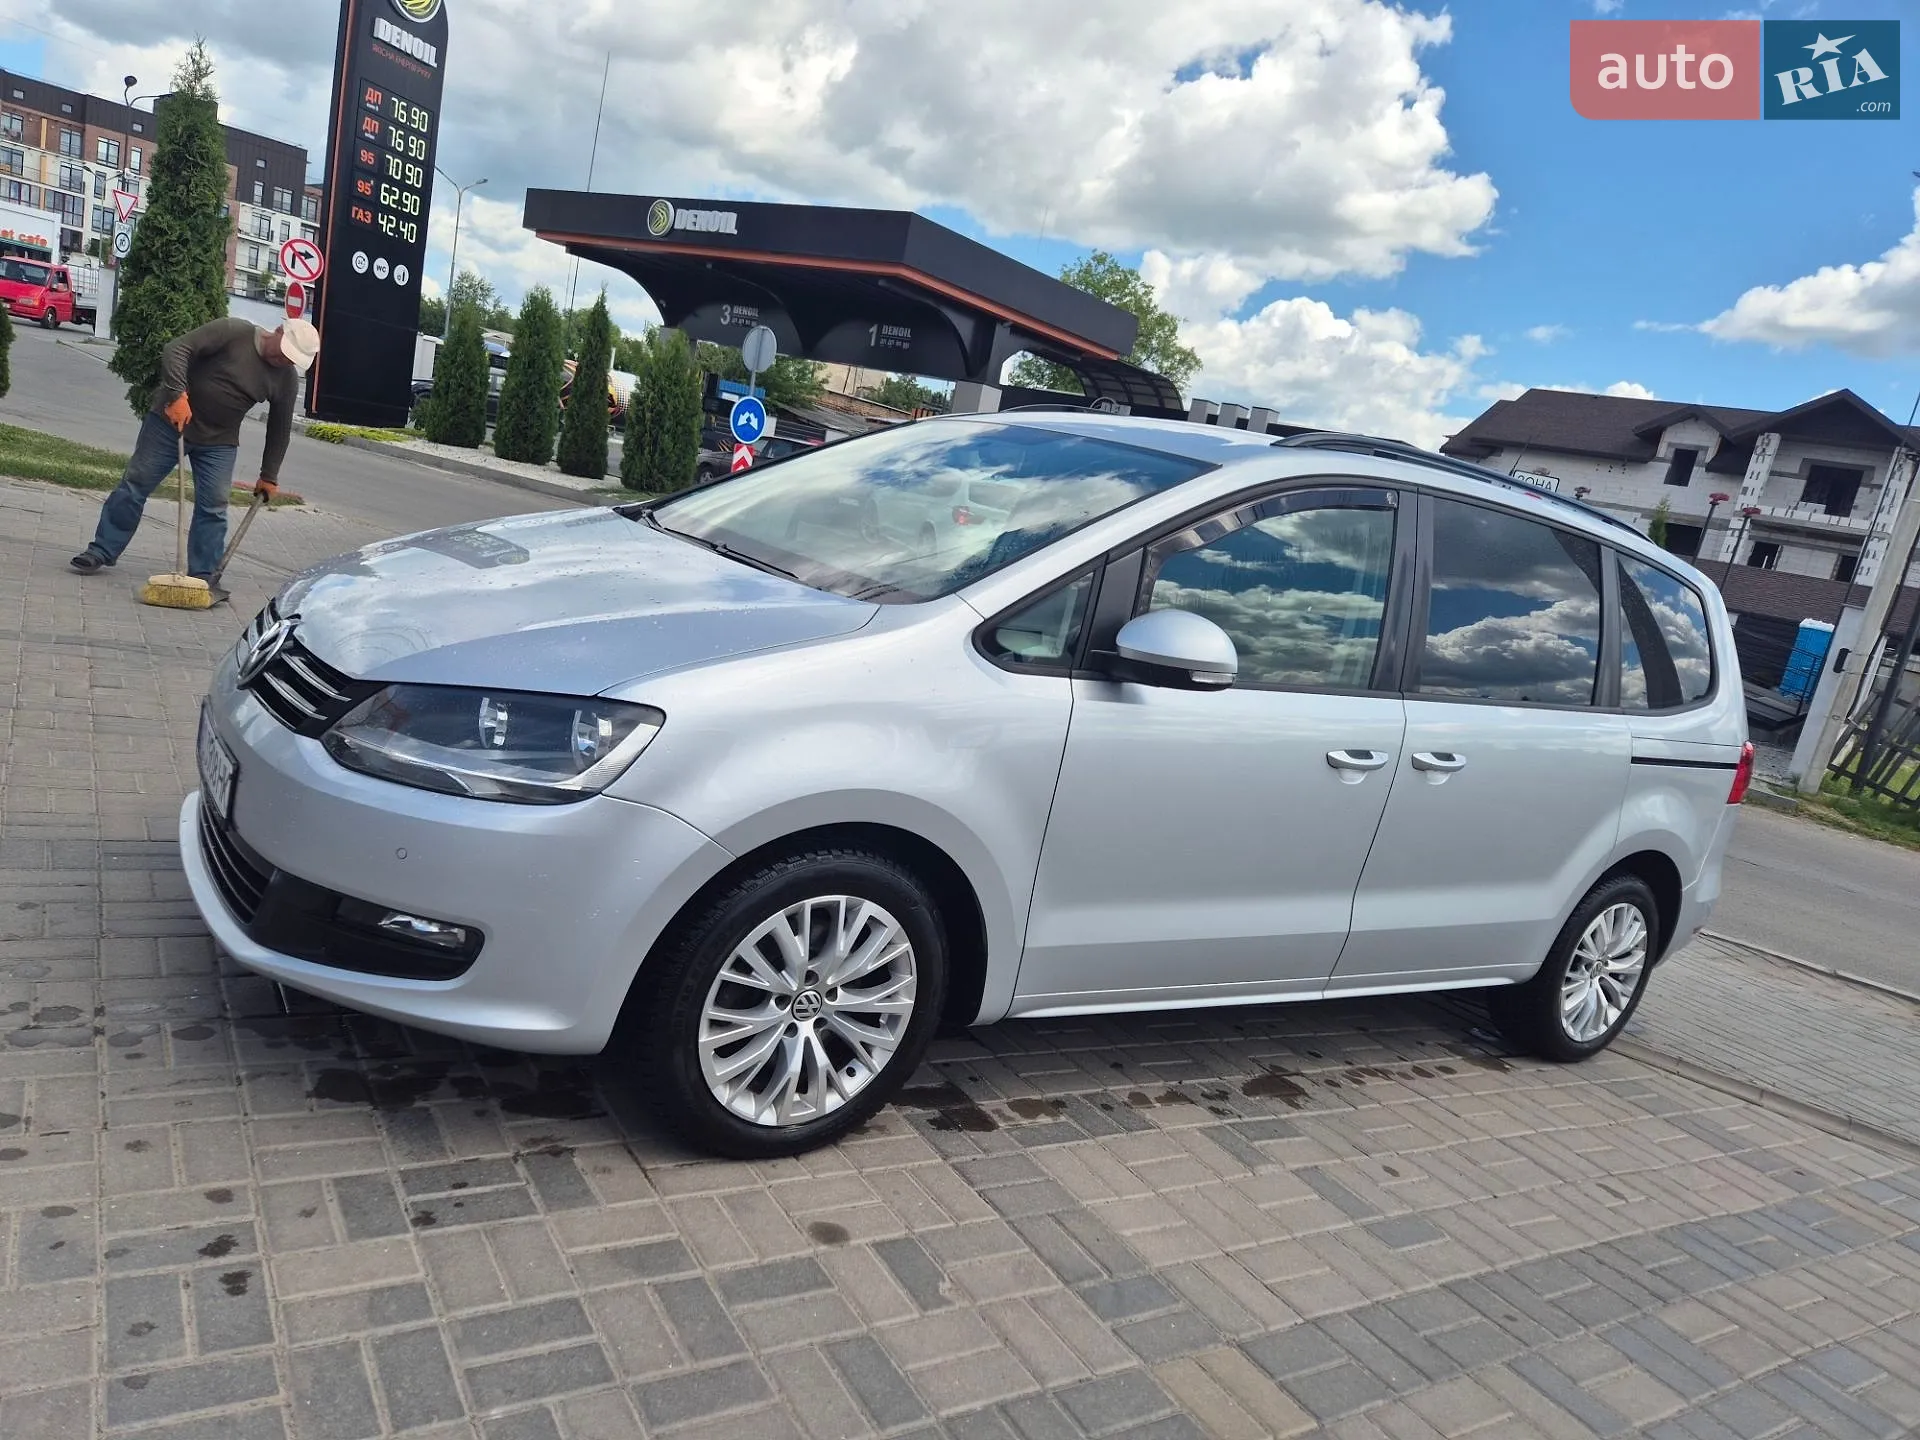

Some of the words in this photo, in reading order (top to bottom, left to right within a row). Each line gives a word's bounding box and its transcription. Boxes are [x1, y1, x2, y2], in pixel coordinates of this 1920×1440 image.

[373, 17, 438, 68] DENOIL
[365, 87, 382, 105] ДП
[391, 97, 428, 132] 76.90
[362, 116, 379, 134] ДП
[360, 149, 375, 165] 95
[380, 183, 420, 216] 62.90
[351, 205, 372, 224] ГАЗ
[378, 212, 417, 243] 42.40
[674, 209, 738, 235] DENOIL
[376, 265, 387, 273] WC
[720, 304, 731, 325] 3
[733, 305, 759, 318] DENOIL
[869, 324, 878, 347] 1
[881, 325, 911, 338] DENOIL
